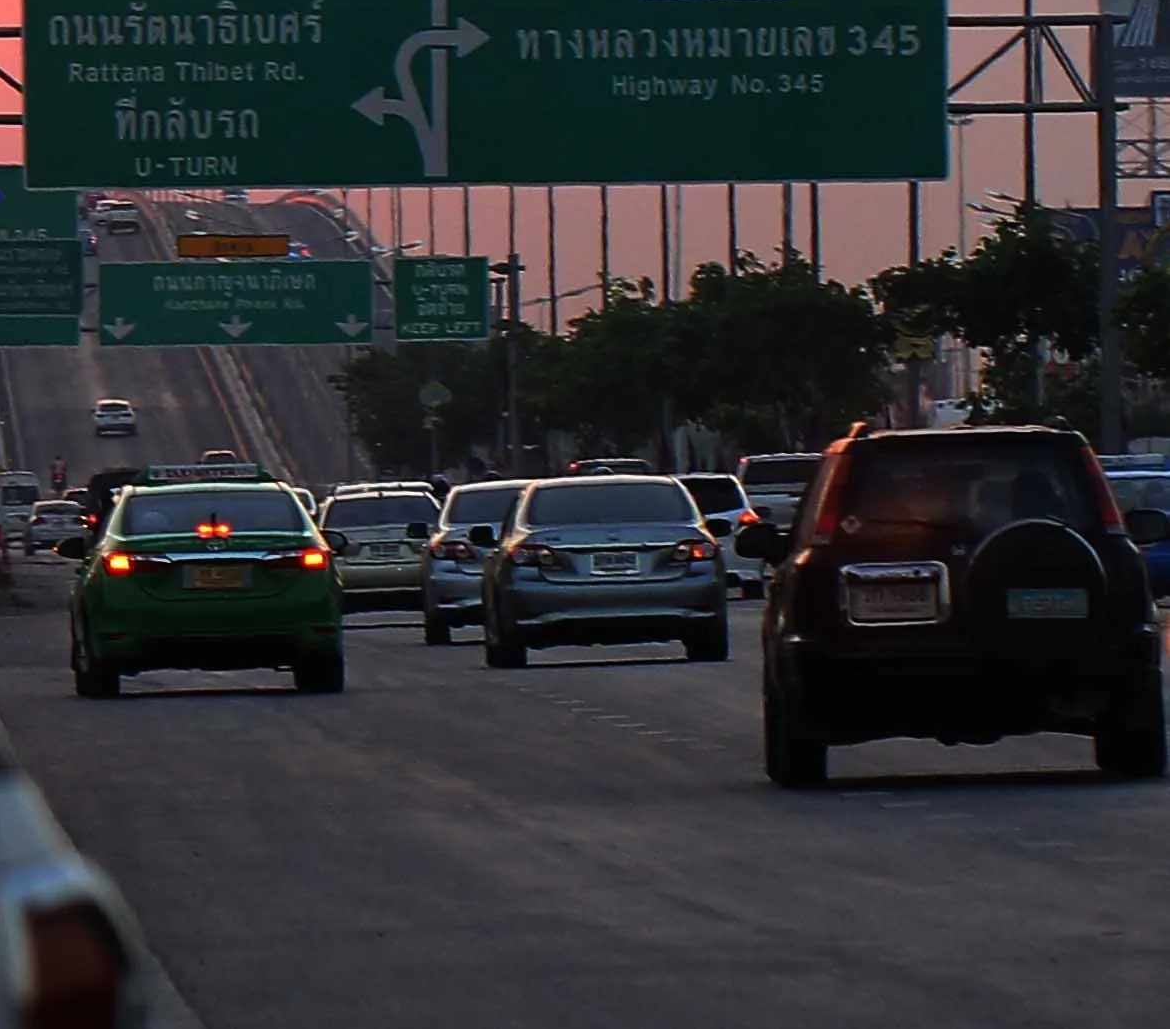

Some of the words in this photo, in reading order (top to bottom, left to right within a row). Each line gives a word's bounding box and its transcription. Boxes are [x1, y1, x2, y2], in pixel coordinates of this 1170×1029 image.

[516, 25, 836, 61] ทางหลวงหมายเลข
[846, 24, 921, 57] 345
[68, 62, 165, 83] Rattana
[174, 61, 257, 82] Thibet
[264, 61, 305, 82] Rd.
[612, 74, 718, 101] Highway
[731, 75, 772, 95] No.
[777, 73, 825, 94] 345
[115, 89, 260, 141] ที่กลับรถ
[134, 155, 238, 177] U-TURN
